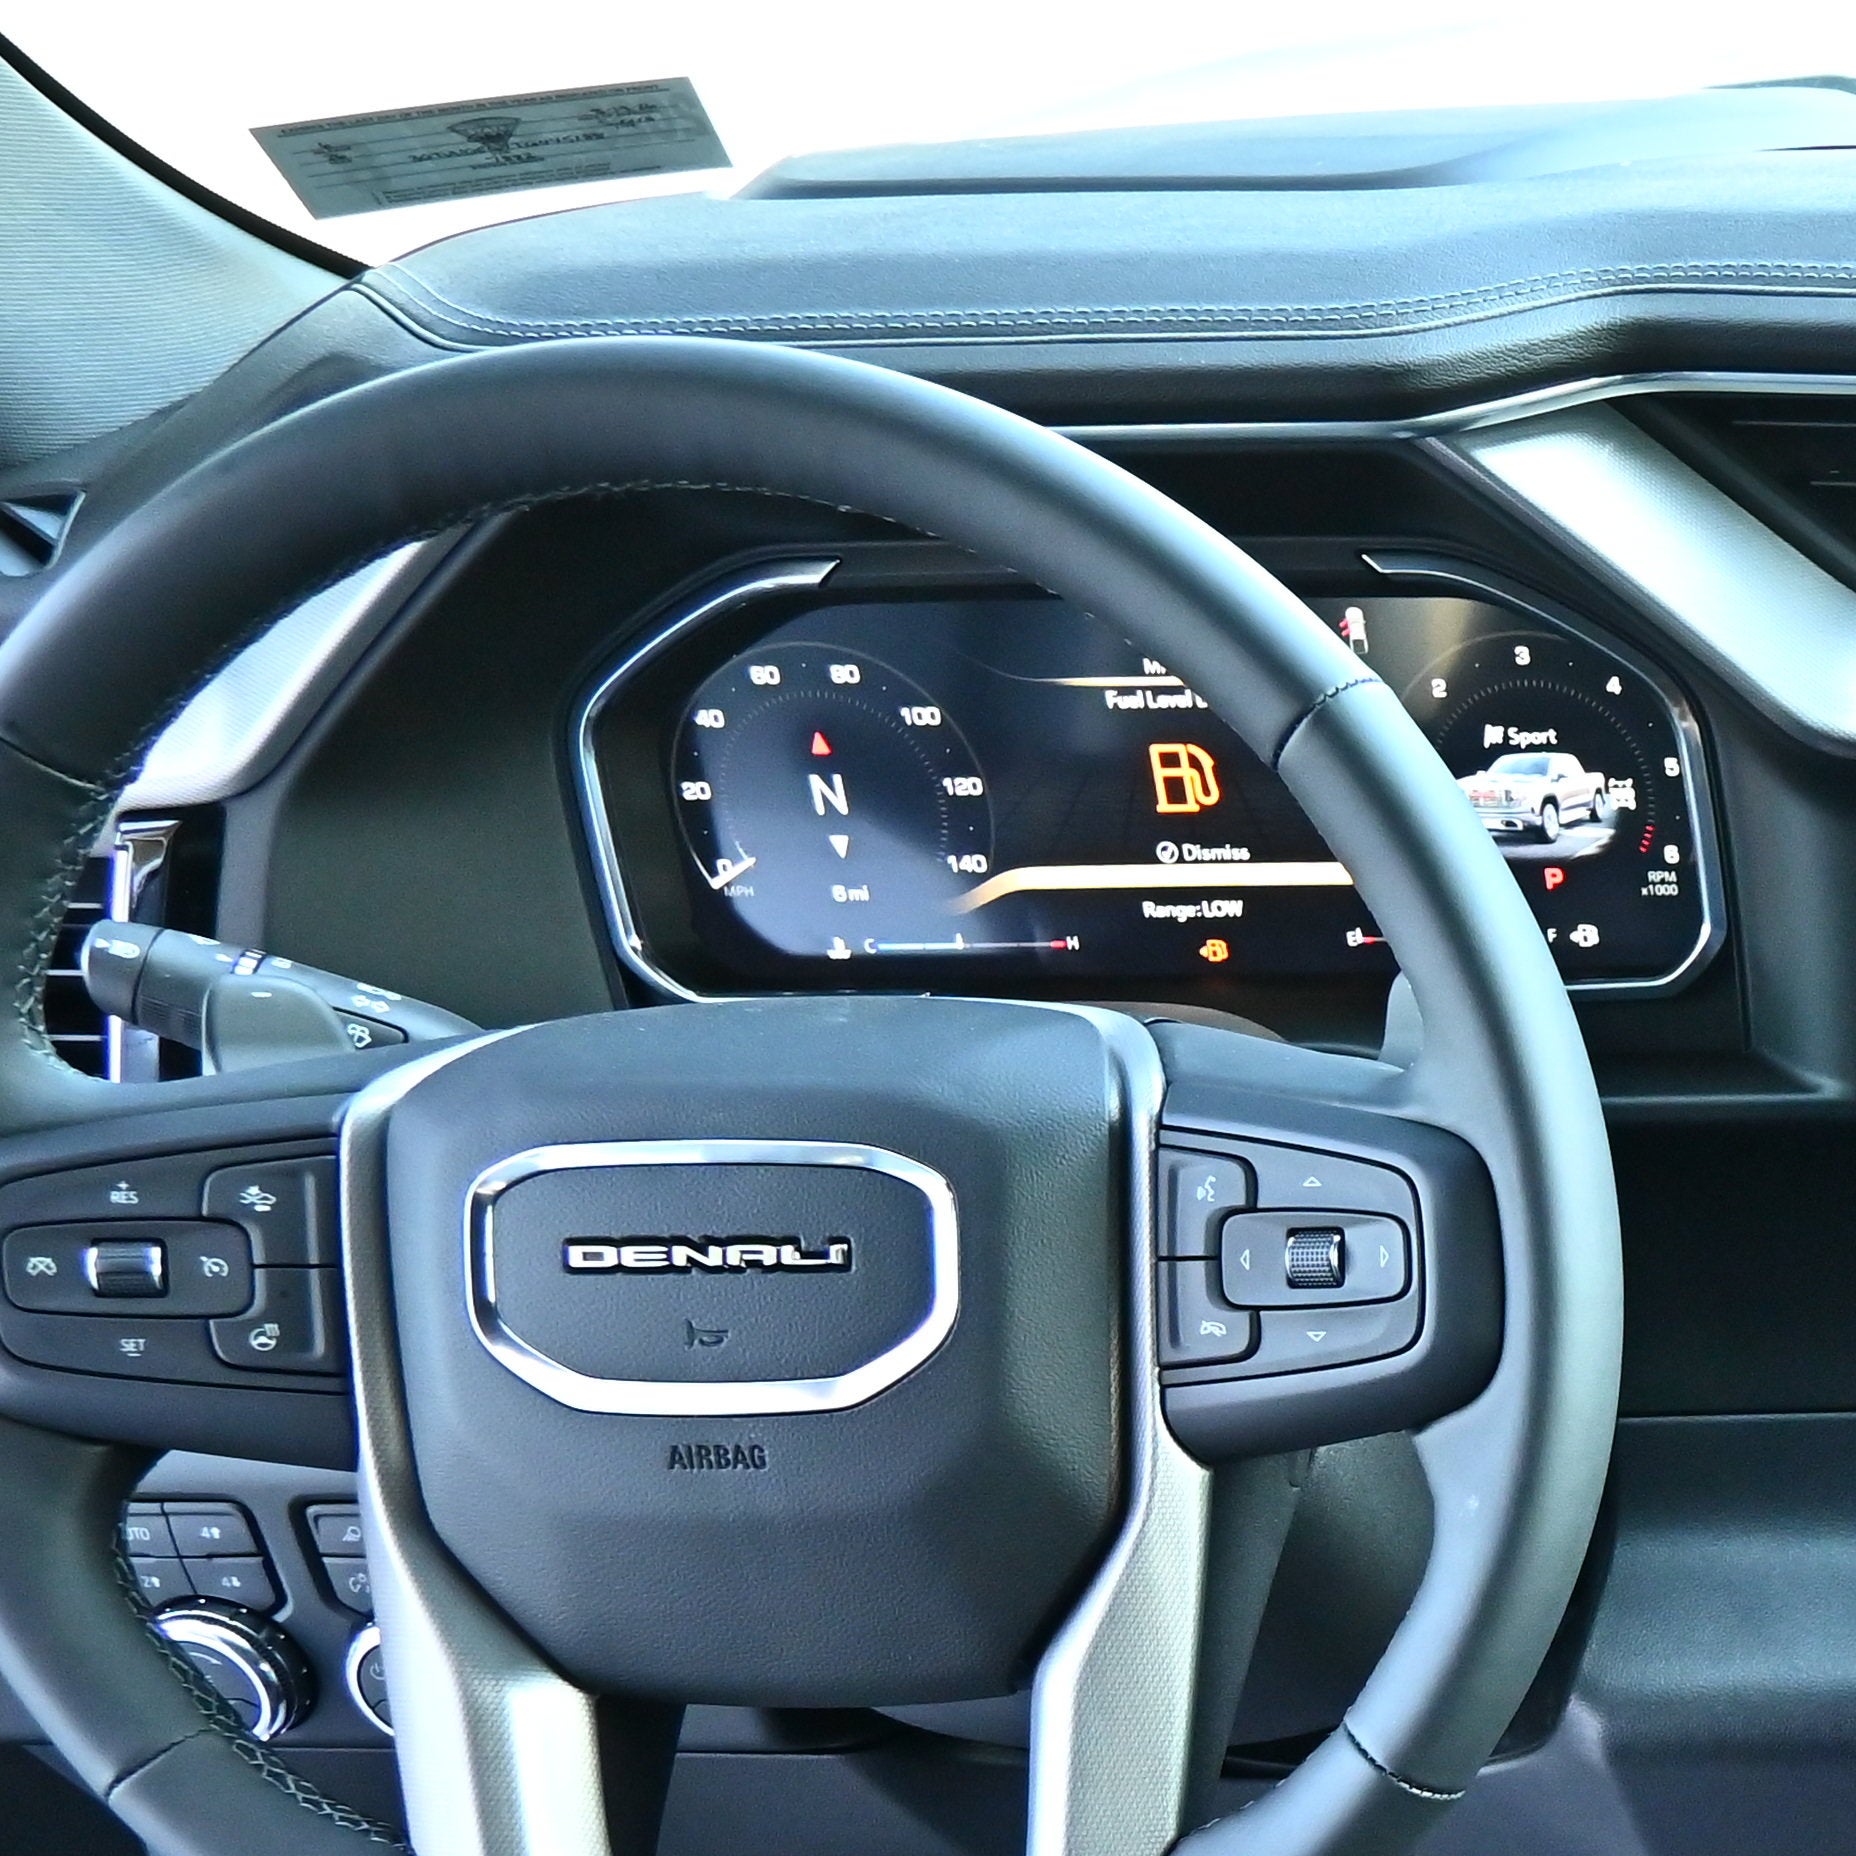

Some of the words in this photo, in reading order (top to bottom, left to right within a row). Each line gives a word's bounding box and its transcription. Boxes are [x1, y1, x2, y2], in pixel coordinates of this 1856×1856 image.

[1514, 645, 1531, 665] 3
[750, 666, 780, 685] 60
[829, 664, 861, 684] 80
[1430, 678, 1448, 698] 2
[1606, 675, 1622, 695] 4
[695, 709, 725, 728] 40
[900, 706, 941, 726] 100
[1509, 727, 1558, 749] Sport
[1664, 757, 1680, 776] 5
[682, 782, 712, 800] 20
[809, 774, 849, 815] N
[942, 777, 983, 796] 120
[1182, 843, 1250, 861] Dismiss
[1664, 845, 1680, 864] 6
[947, 854, 988, 873] 140
[1544, 867, 1564, 890] P
[1647, 871, 1677, 883] RPM
[724, 886, 754, 897] MPH
[1641, 884, 1678, 896] x1000
[1066, 935, 1079, 950] H
[1547, 928, 1557, 942] F
[864, 938, 877, 954] C
[110, 1191, 139, 1205] RES
[564, 1240, 850, 1270] DENALI
[120, 1338, 146, 1352] SET
[667, 1444, 768, 1471] AIRBAG
